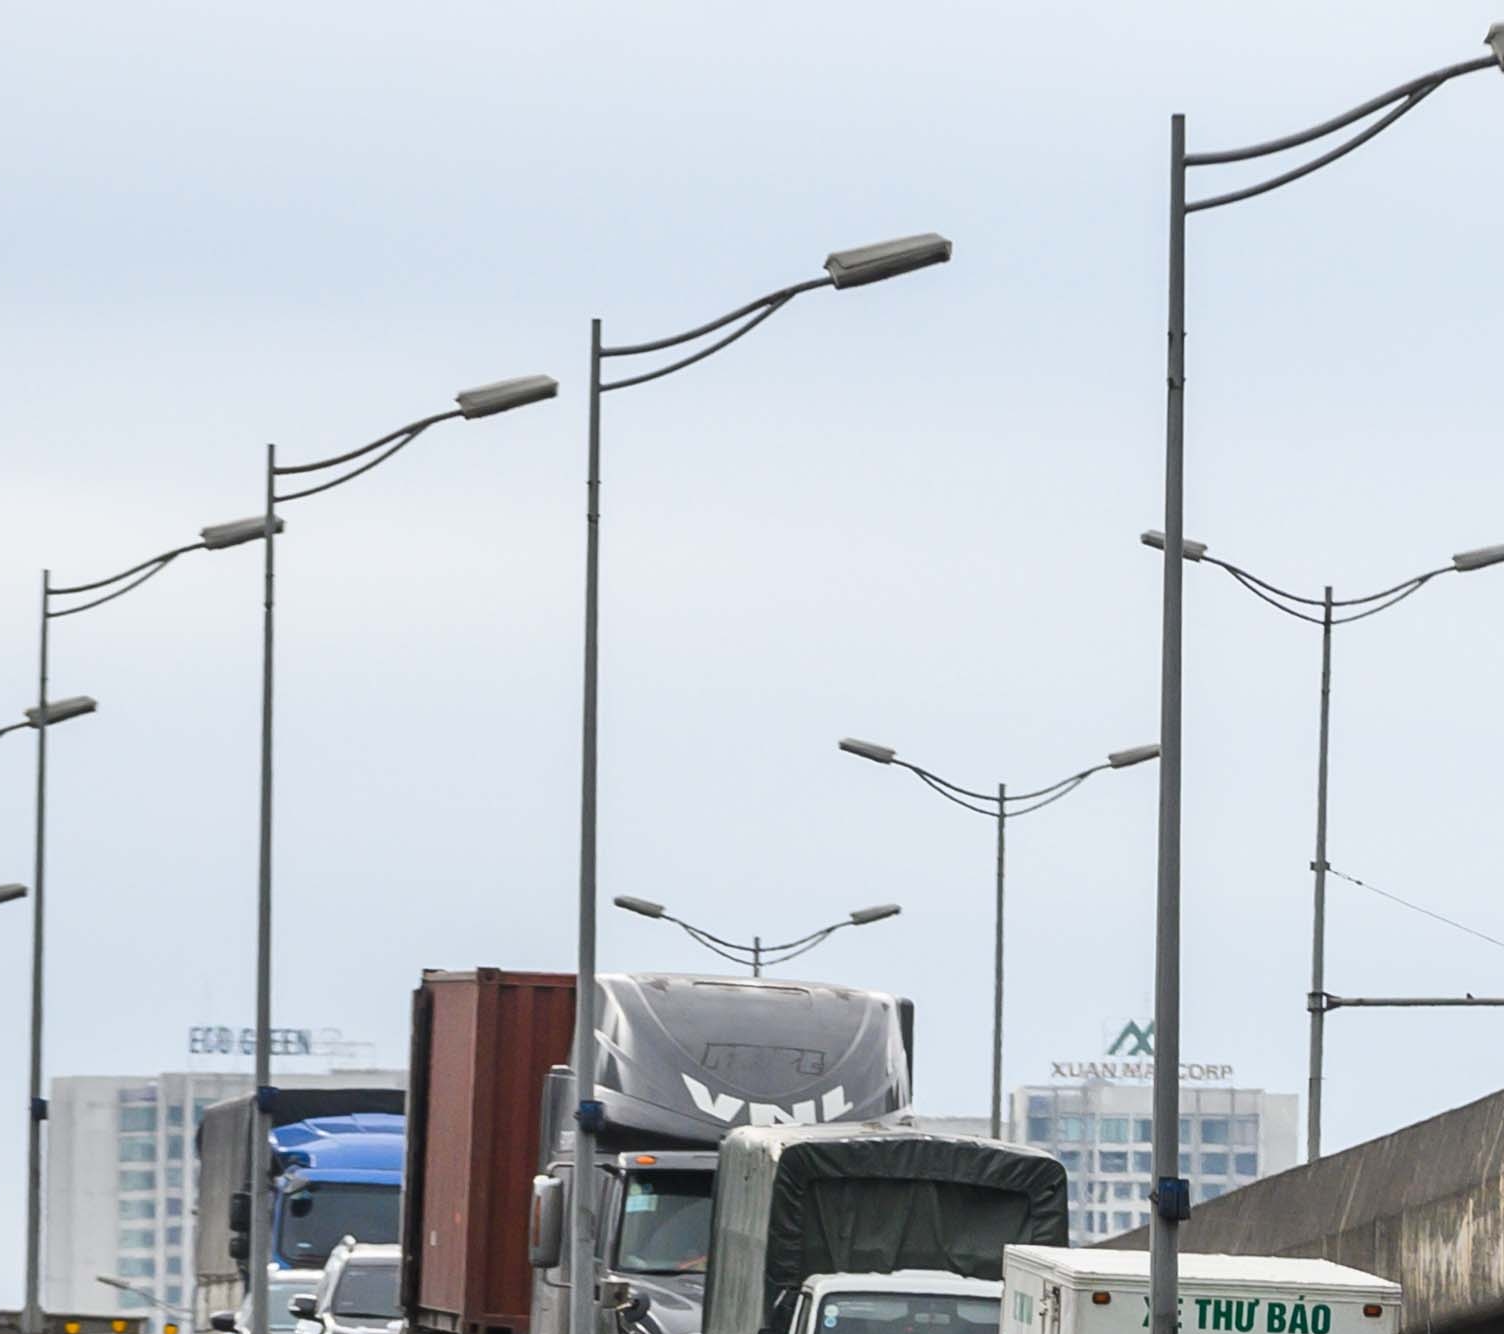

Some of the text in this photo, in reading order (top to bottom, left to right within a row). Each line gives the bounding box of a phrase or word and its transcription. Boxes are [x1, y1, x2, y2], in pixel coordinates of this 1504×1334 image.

[239, 1028, 313, 1056] GEEN
[1178, 1063, 1234, 1082] CORP
[1195, 1298, 1260, 1334] THƯ
